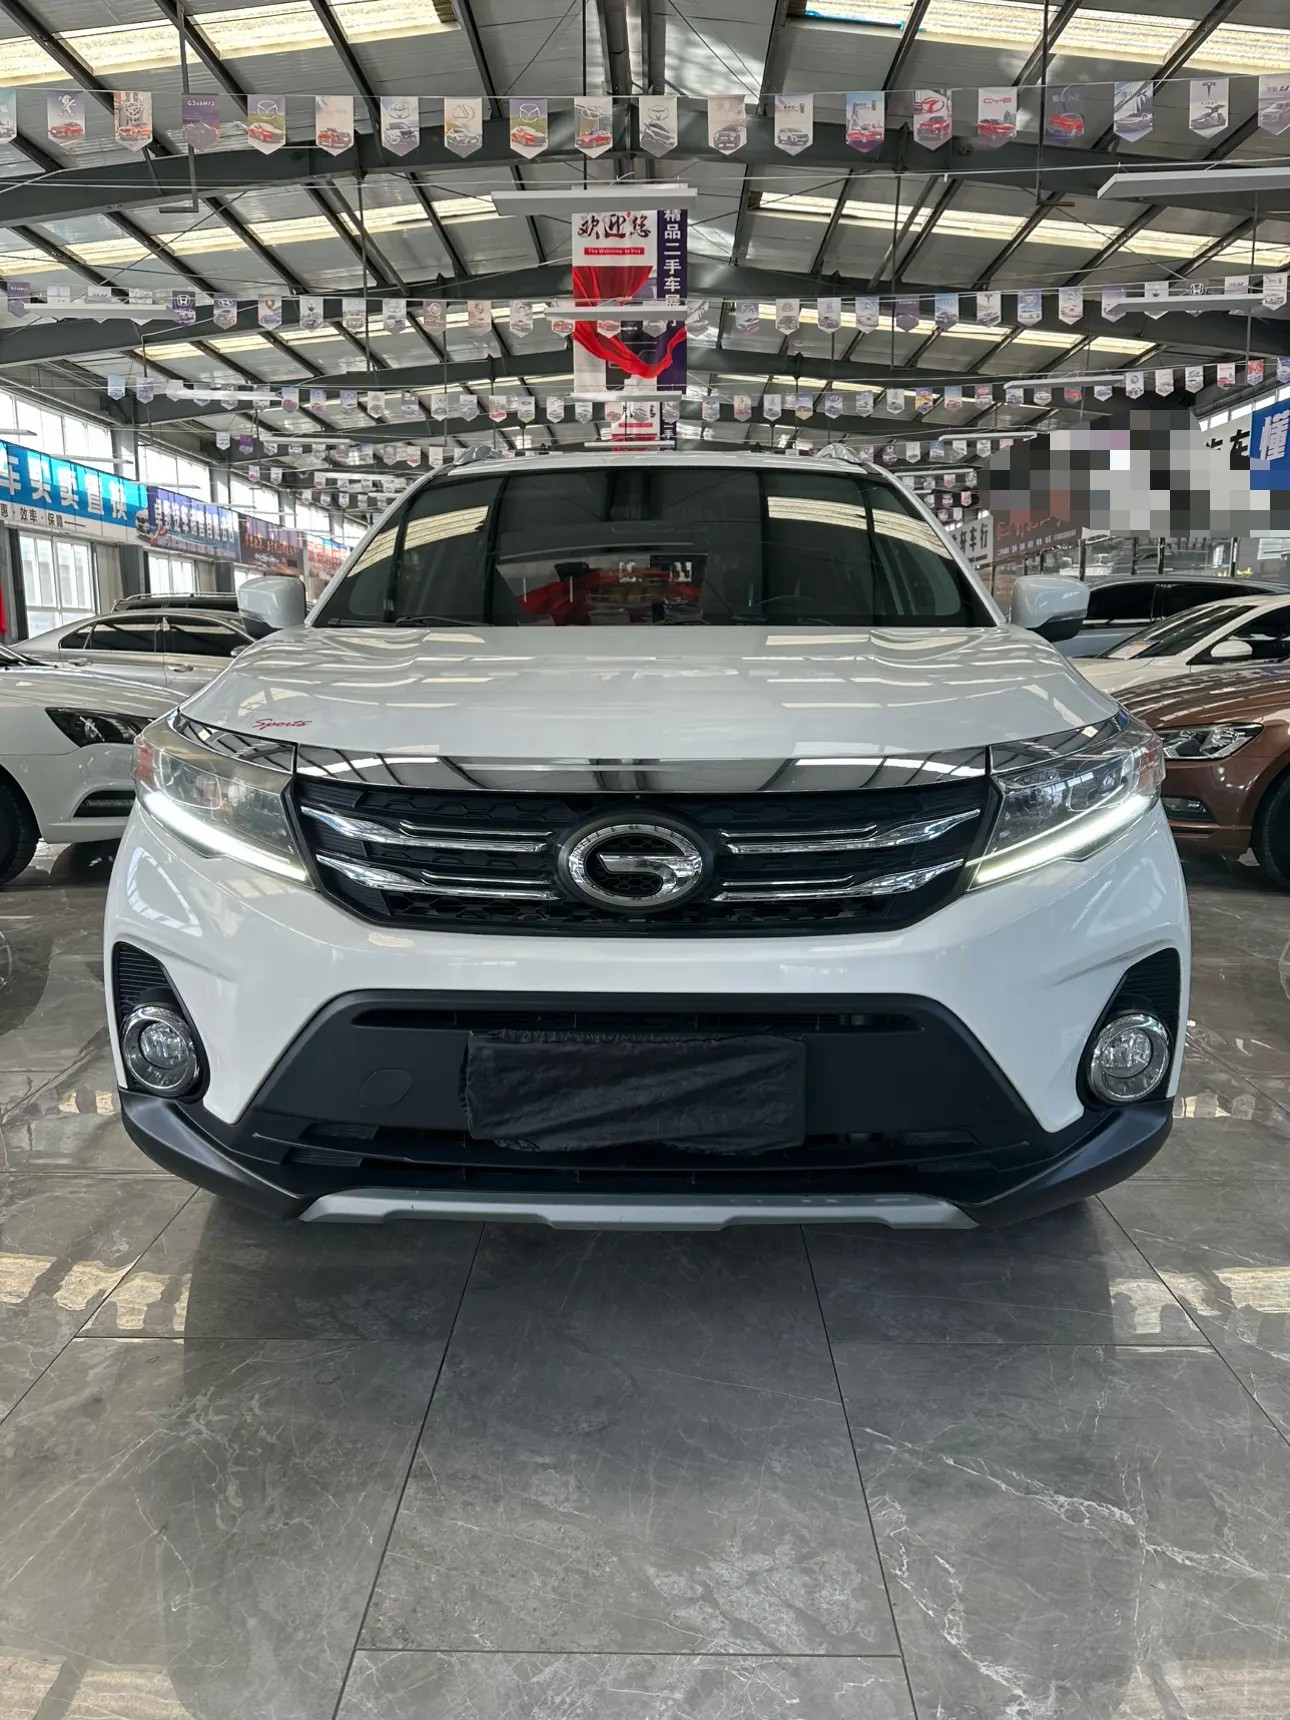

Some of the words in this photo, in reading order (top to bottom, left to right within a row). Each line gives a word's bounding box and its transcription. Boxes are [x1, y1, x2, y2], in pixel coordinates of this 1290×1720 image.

[577, 214, 652, 240] 欢迎您
[252, 718, 312, 731] Sports
